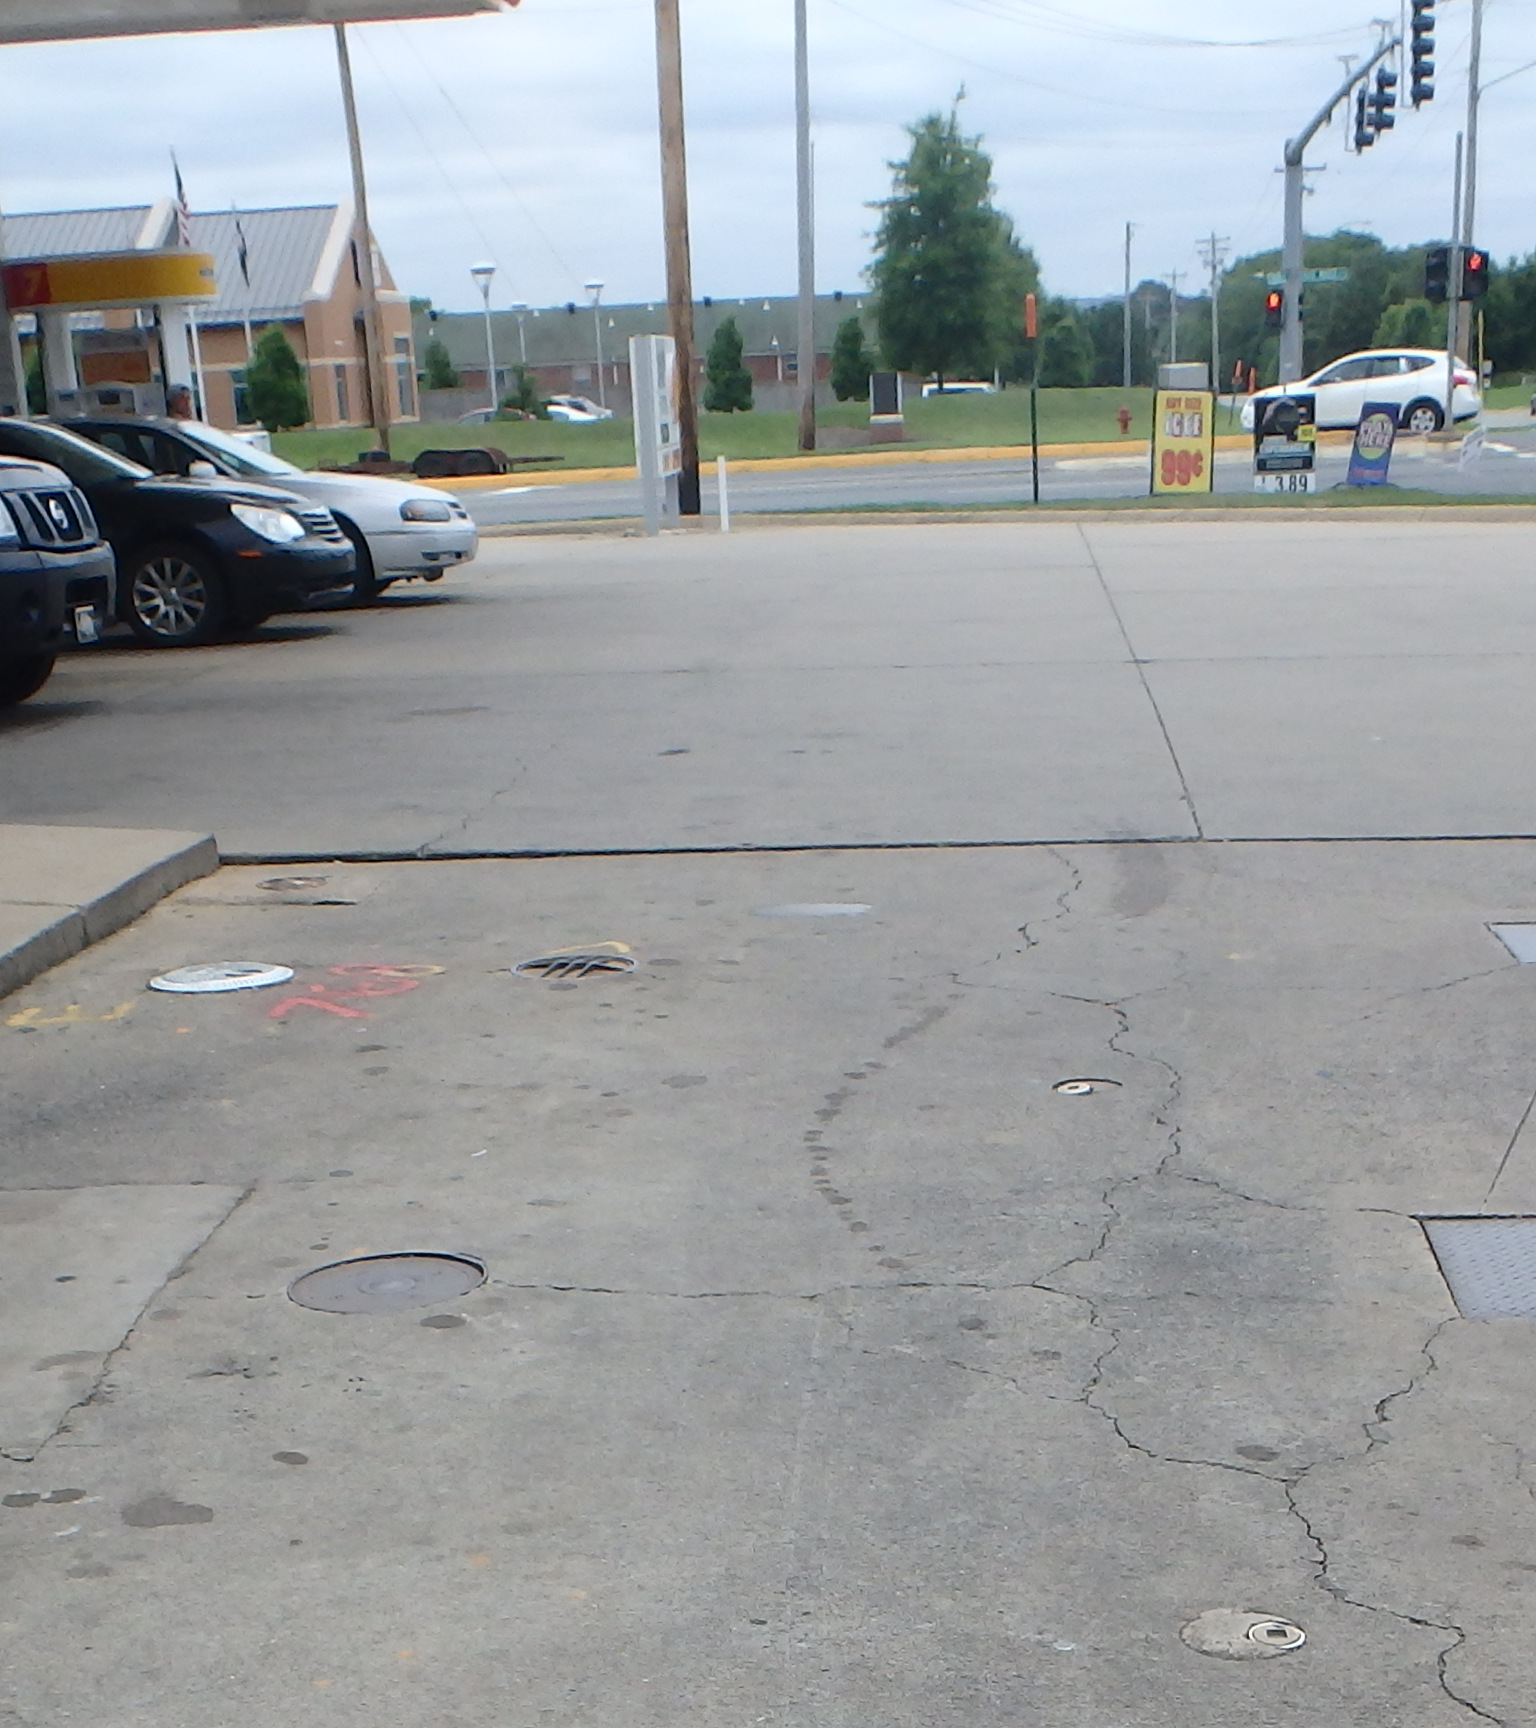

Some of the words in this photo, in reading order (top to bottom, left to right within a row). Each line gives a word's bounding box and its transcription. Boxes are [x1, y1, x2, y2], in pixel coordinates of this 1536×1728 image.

[1163, 412, 1203, 437] ICEE
[1360, 420, 1393, 436] PLAY
[1357, 433, 1390, 448] HERE
